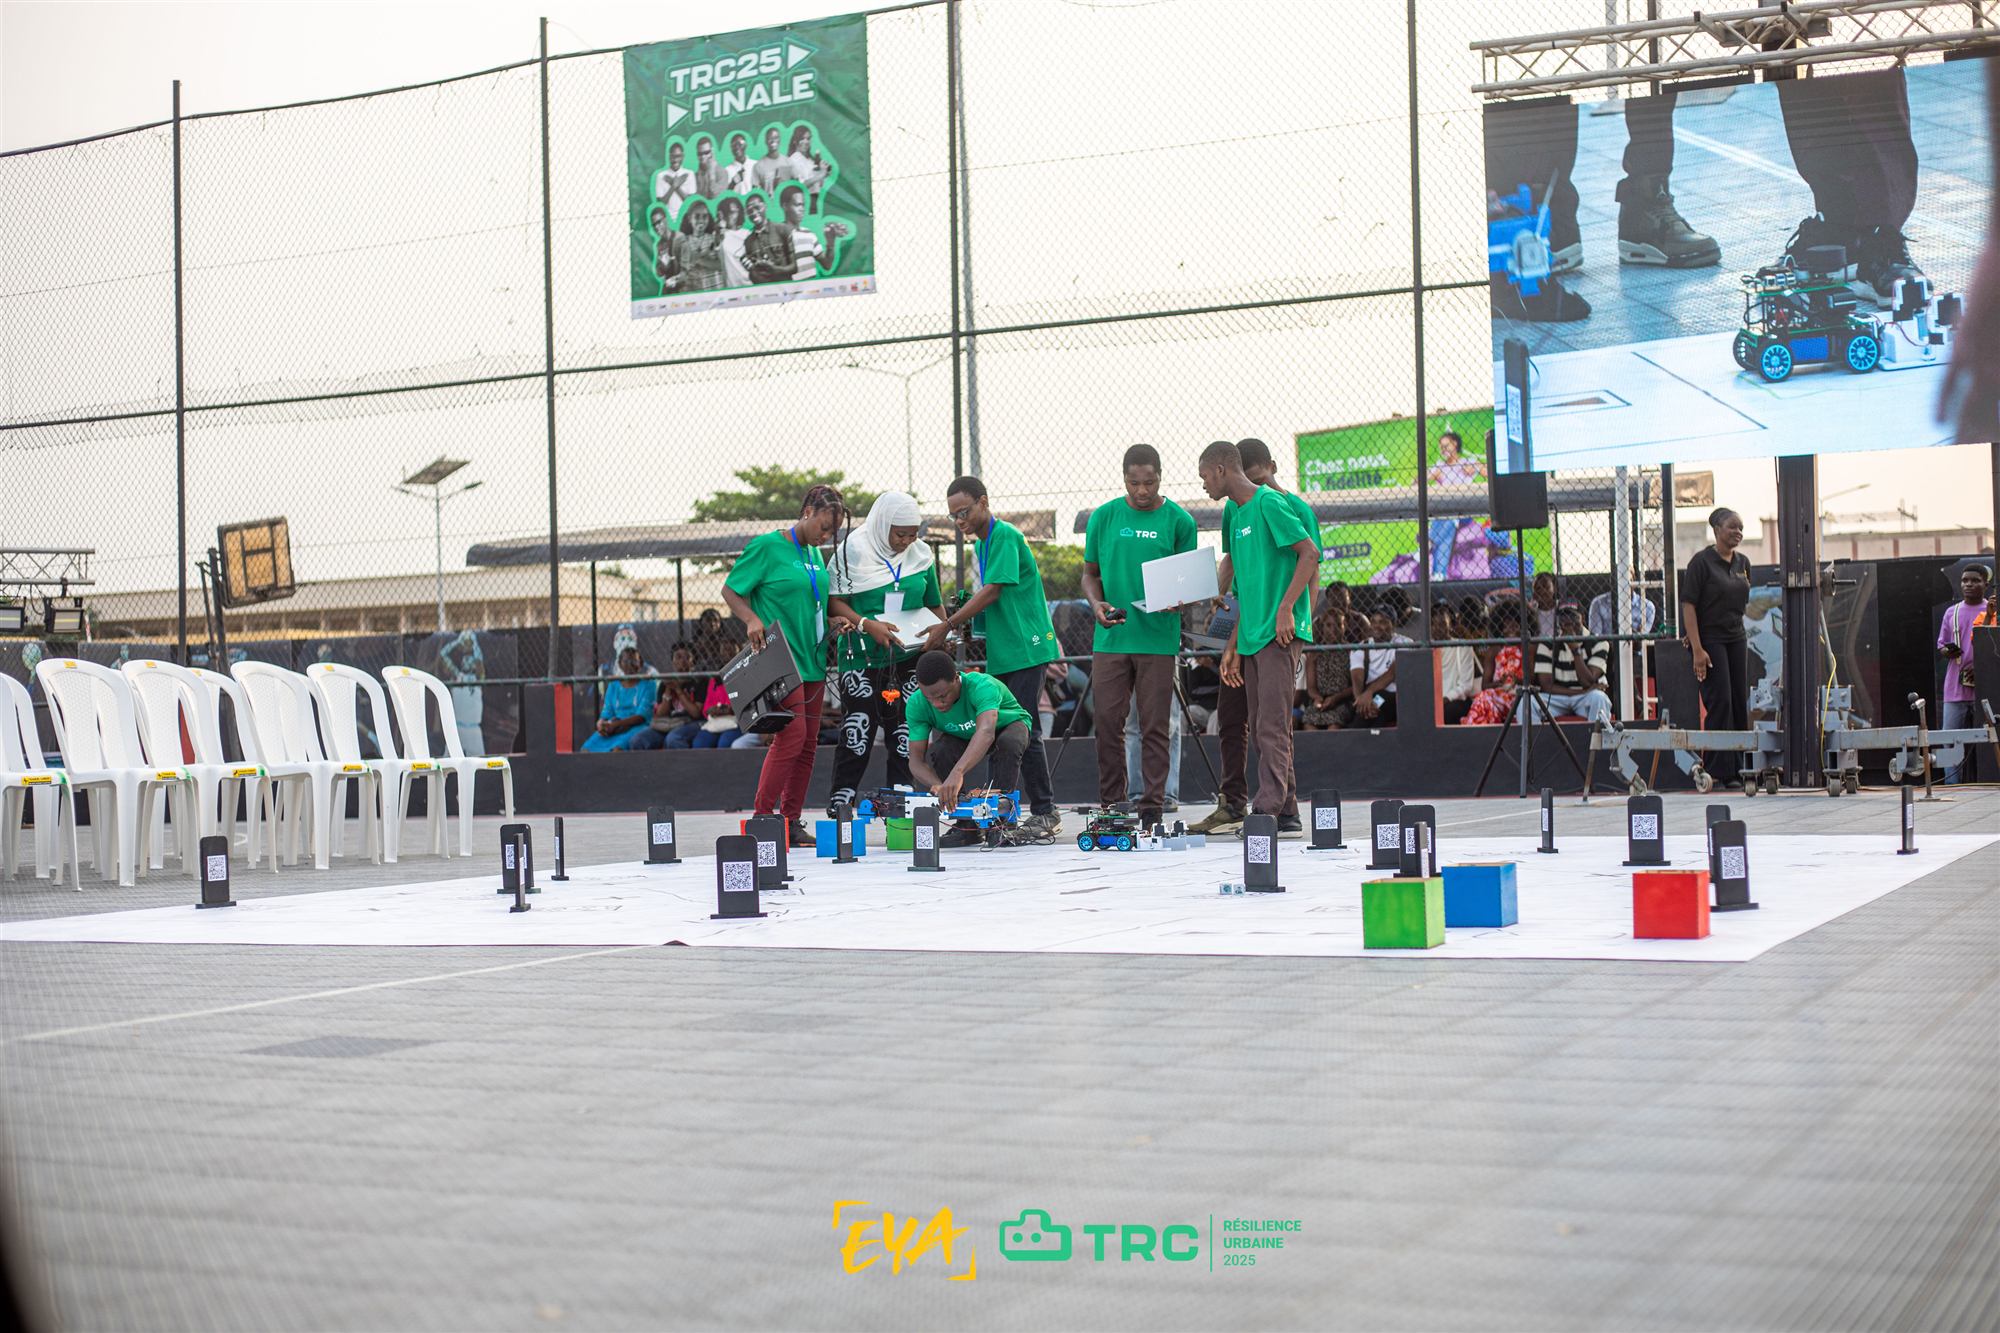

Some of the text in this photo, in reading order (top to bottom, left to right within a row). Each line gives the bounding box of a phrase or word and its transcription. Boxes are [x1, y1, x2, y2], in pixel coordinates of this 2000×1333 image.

[669, 47, 782, 94] TRC25
[692, 73, 815, 123] FINALE
[1136, 530, 1158, 538] TRC
[1242, 526, 1252, 537] TRC
